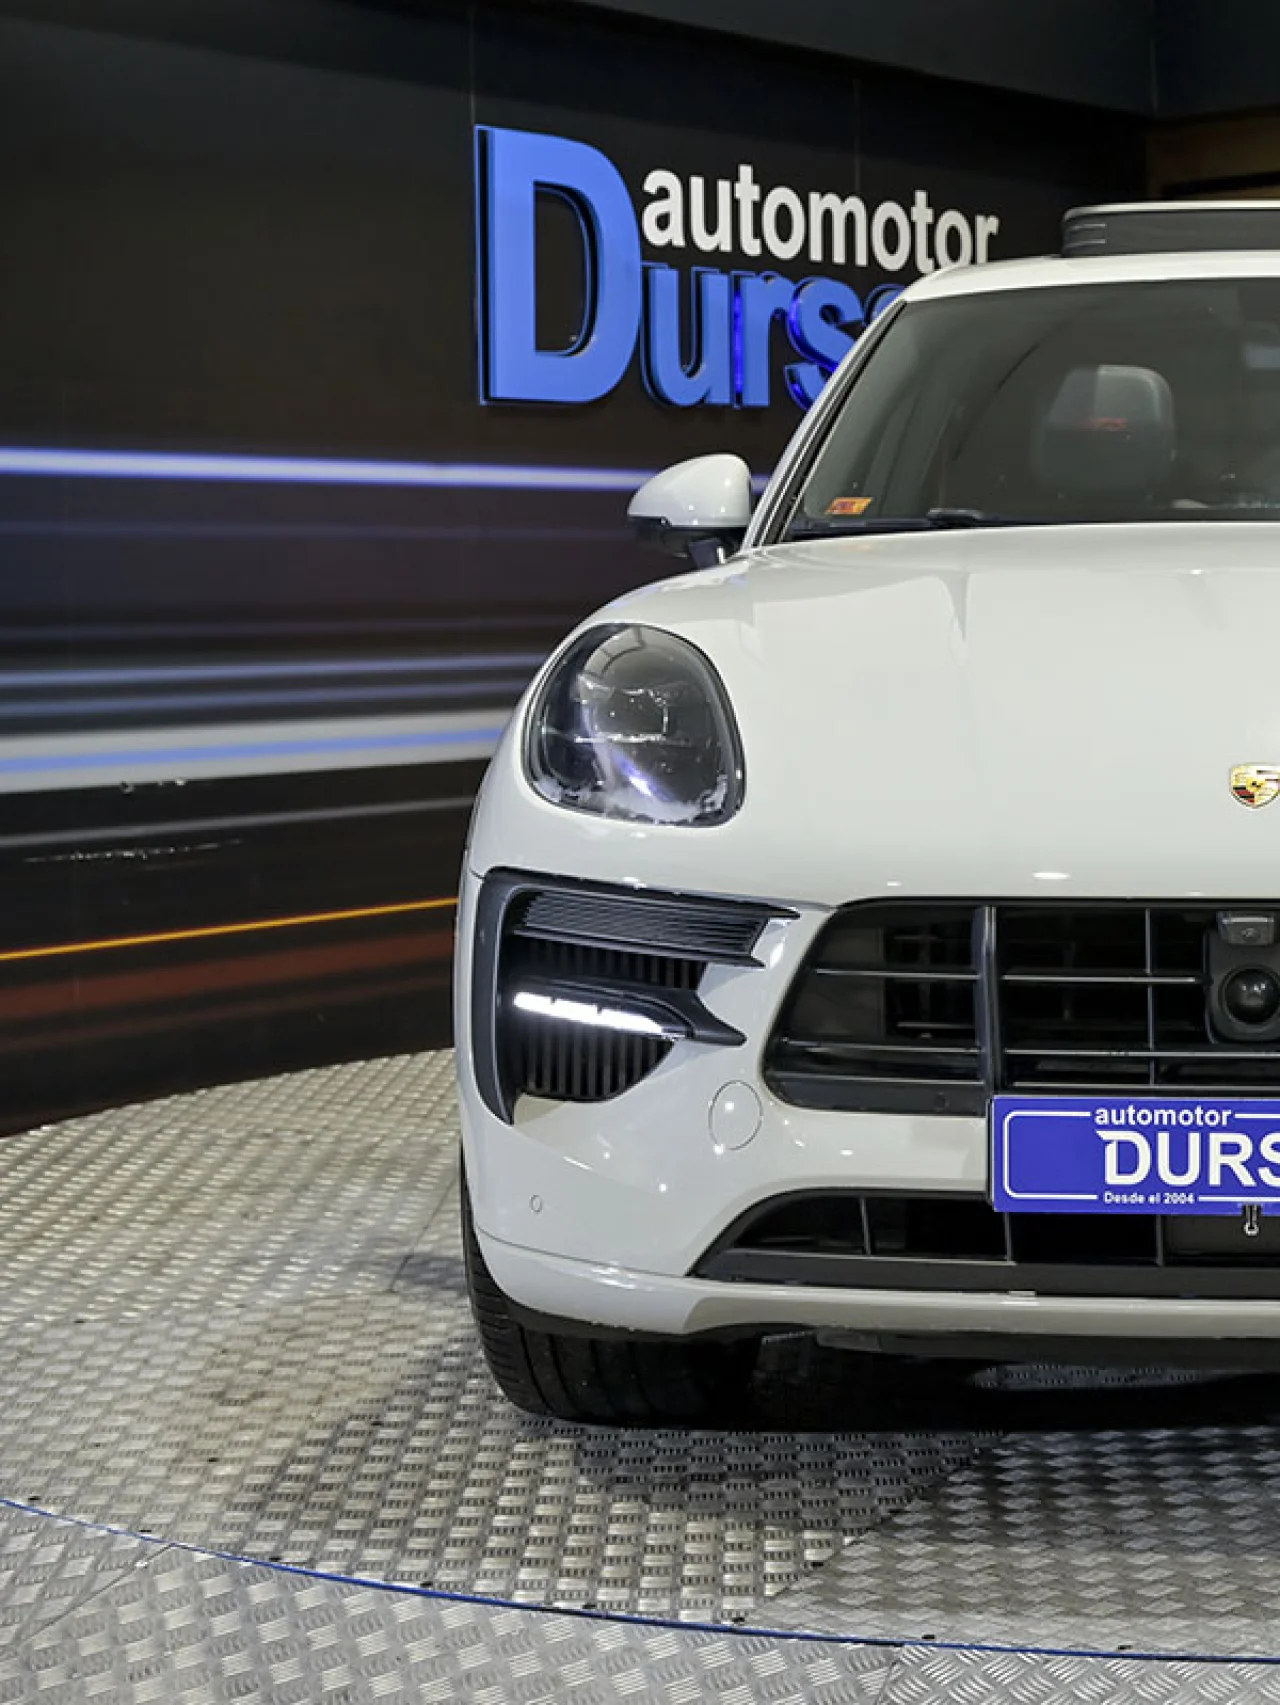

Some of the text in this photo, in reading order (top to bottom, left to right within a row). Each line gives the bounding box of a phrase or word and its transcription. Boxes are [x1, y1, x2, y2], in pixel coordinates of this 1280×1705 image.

[642, 163, 1000, 271] automotor
[475, 124, 906, 411] Durs
[1094, 1105, 1232, 1125] automotor
[1104, 1191, 1195, 1205] Desde el 2004
